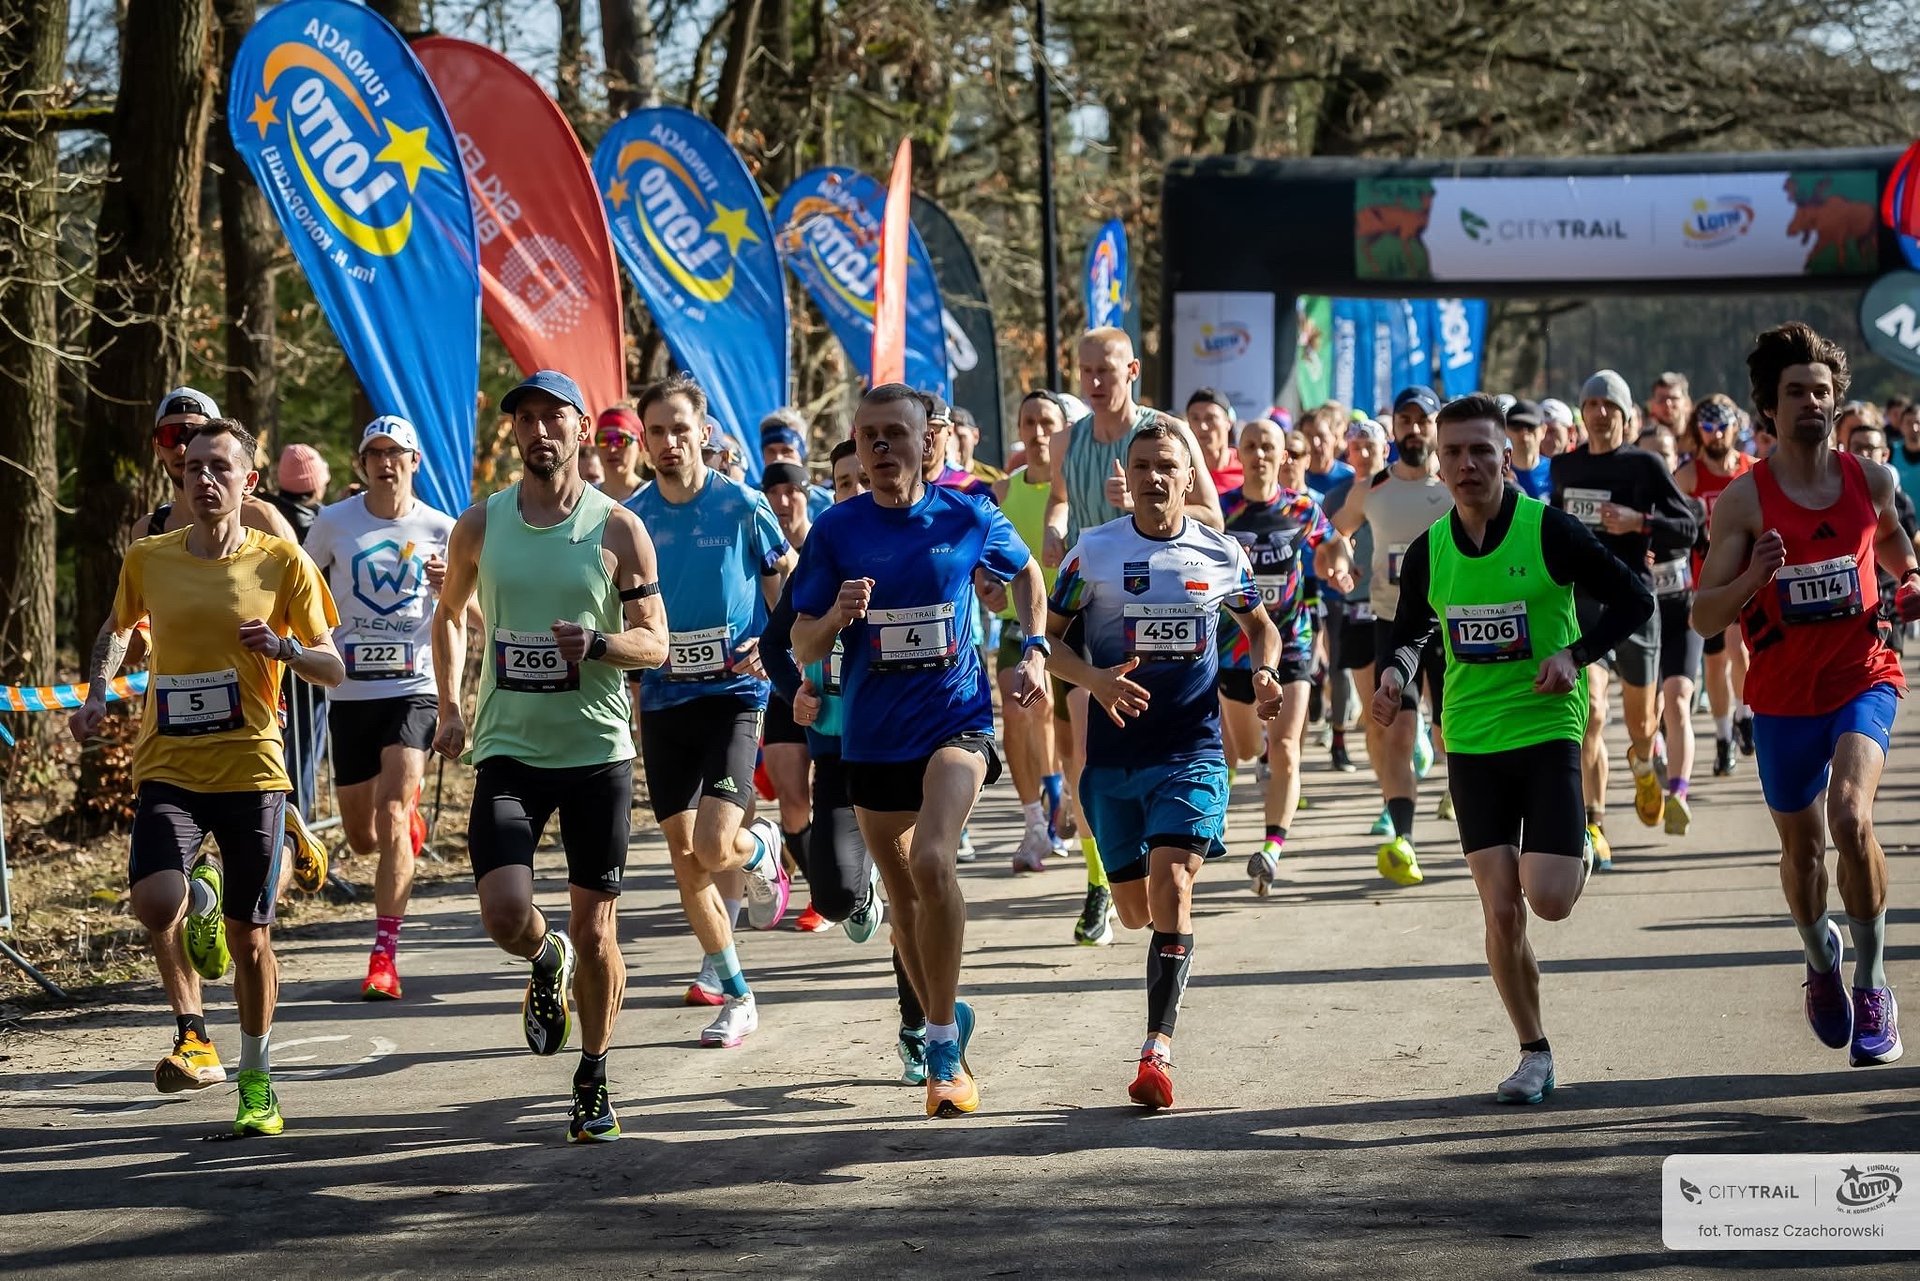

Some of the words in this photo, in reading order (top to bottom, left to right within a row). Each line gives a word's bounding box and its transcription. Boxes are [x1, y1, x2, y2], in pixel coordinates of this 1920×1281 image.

[1797, 577, 1842, 601] 1114
[905, 628, 921, 646] 4
[1144, 622, 1188, 639] 456
[1460, 621, 1514, 641] 1206
[362, 646, 397, 662] 222
[513, 650, 557, 669] 266
[675, 645, 714, 664] 359
[190, 693, 204, 711] 5
